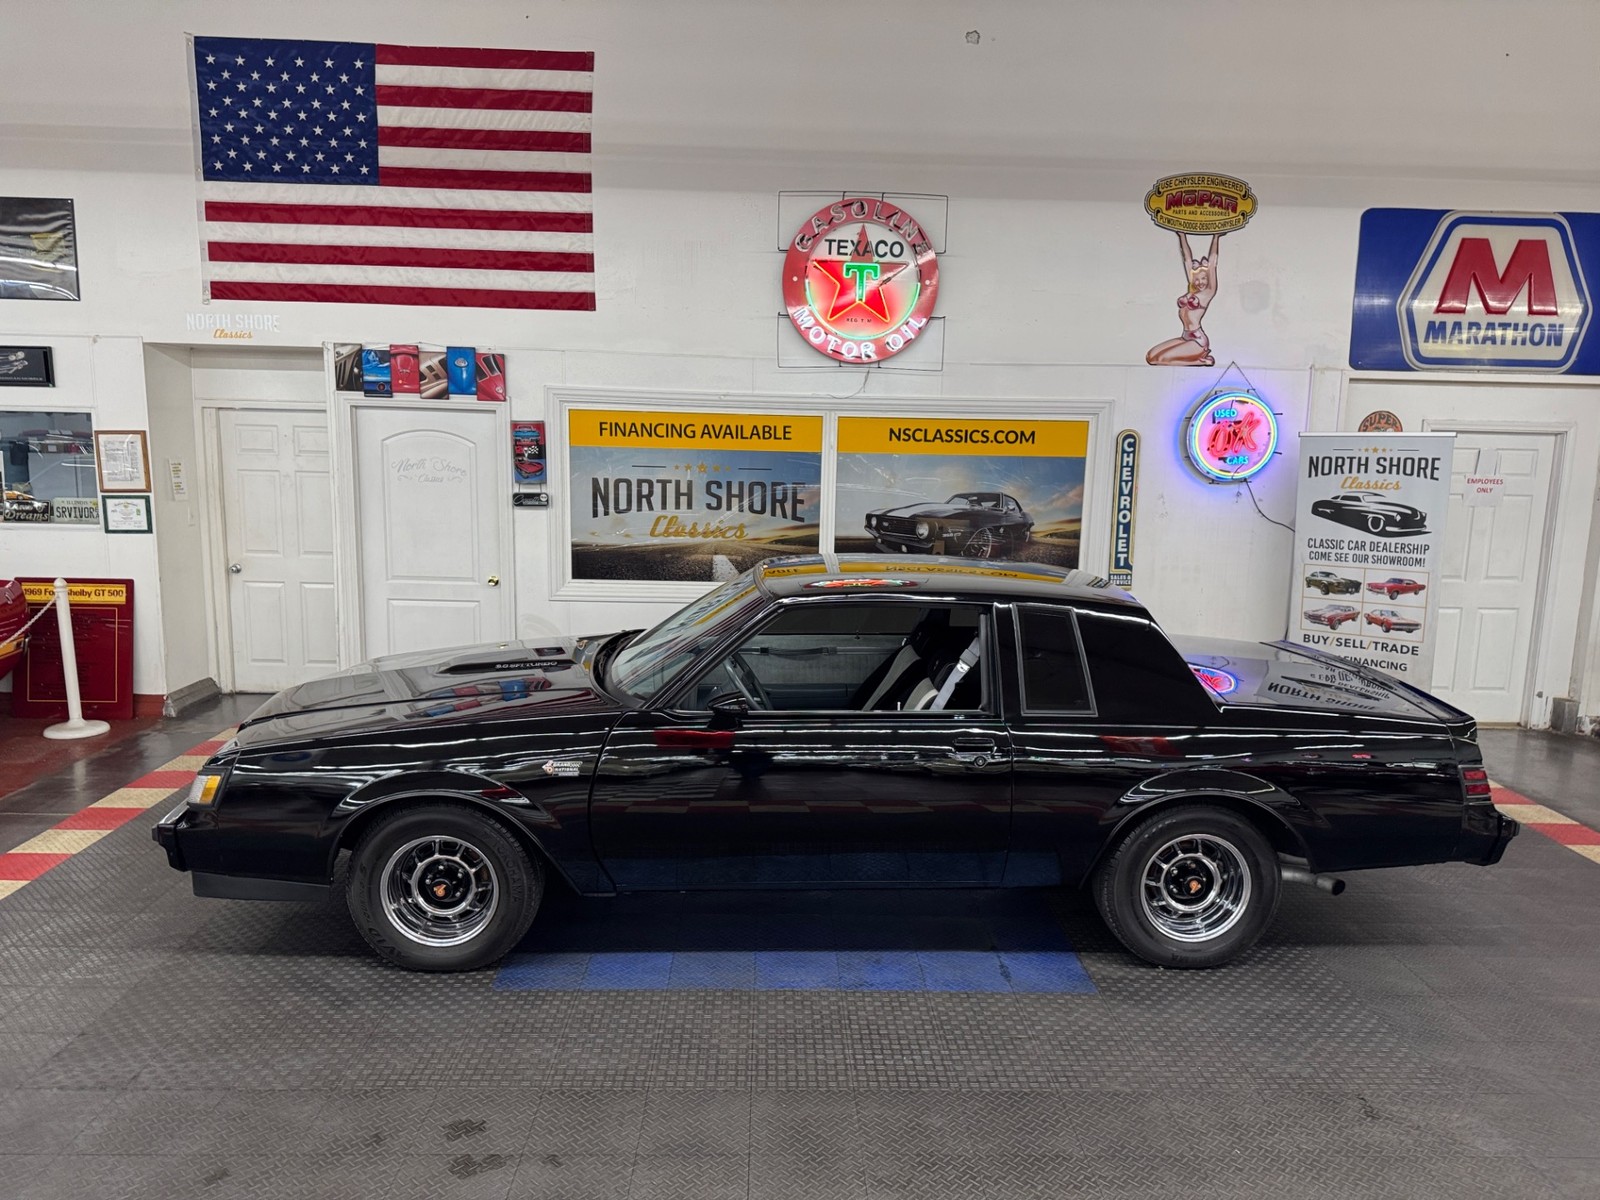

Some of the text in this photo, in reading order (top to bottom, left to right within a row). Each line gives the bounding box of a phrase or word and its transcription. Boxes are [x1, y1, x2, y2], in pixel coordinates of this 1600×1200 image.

[1161, 176, 1244, 192] USE CHRYSLER ENGINEERED
[824, 238, 904, 258] TEXACO
[1434, 238, 1558, 316] M
[186, 312, 280, 333] NORTH SHORE
[213, 328, 254, 339] Classics
[794, 306, 927, 360] MOTOR OIL
[1424, 320, 1564, 346] MARATHON
[1214, 408, 1238, 418] USED
[1362, 412, 1399, 432] SUPER
[598, 421, 792, 441] FINANCING AVAILABLE
[888, 427, 1036, 444] NSCLASSICS.COM
[1226, 455, 1249, 465] CARS
[1308, 456, 1442, 482] NORTH SHORE
[1340, 476, 1402, 490] Classics
[591, 476, 806, 523] NORTH SHORE
[1117, 438, 1135, 567] CHEVROLET
[4, 510, 48, 520] Dreams
[650, 515, 750, 540] Classics
[1308, 538, 1430, 555] CLASSIC CAR DEALERSHIP
[1308, 550, 1426, 568] COME SEE OUR SHOWROOM!
[108, 590, 124, 598] 500
